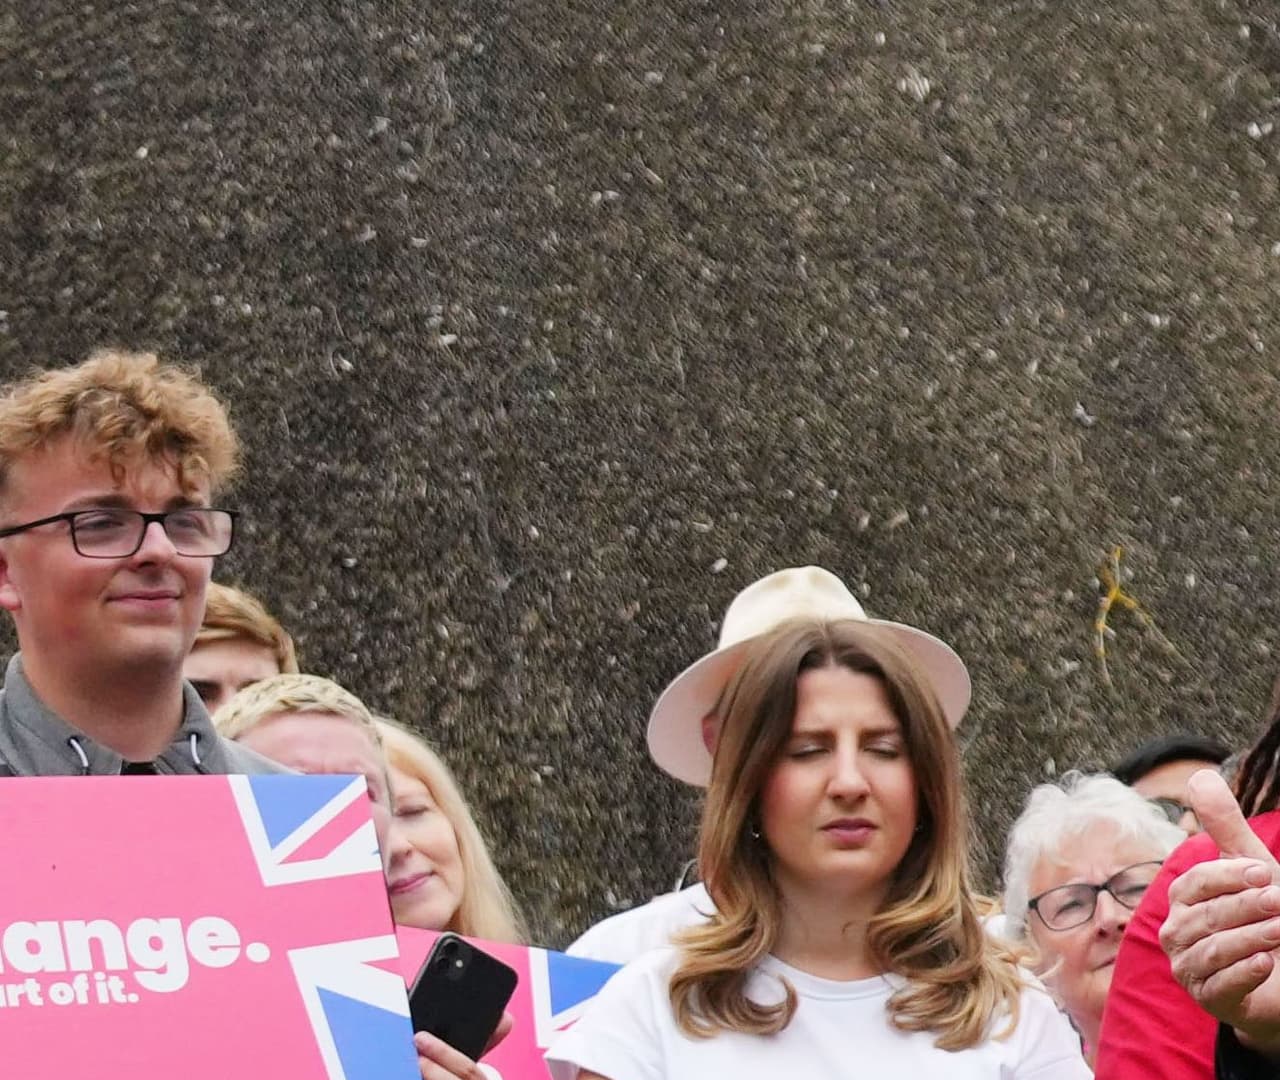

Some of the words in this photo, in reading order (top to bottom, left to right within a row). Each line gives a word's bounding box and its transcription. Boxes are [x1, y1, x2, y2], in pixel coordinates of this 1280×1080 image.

[0, 916, 271, 993] ange.
[49, 974, 89, 1005] of
[93, 971, 140, 1004] it.
